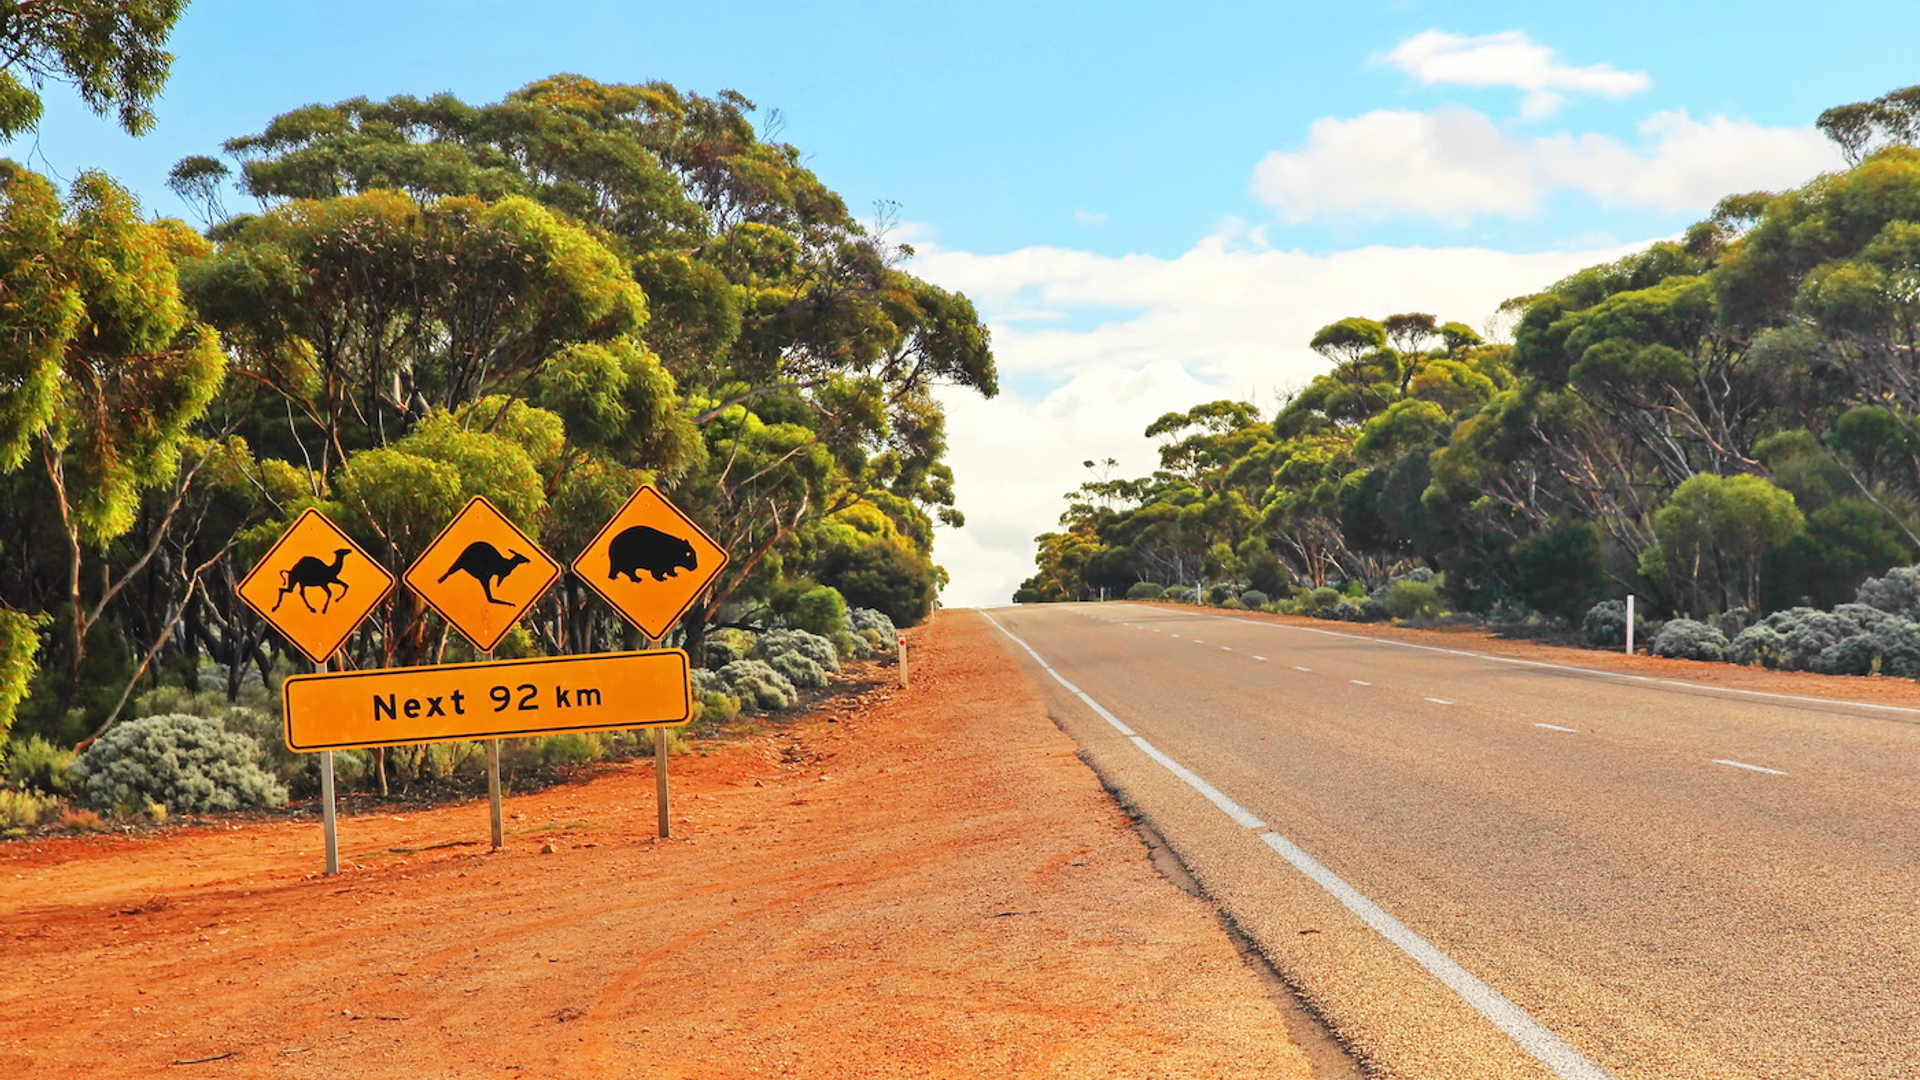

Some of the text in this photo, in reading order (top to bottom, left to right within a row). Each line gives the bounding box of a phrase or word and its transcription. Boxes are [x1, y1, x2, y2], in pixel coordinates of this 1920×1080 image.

[373, 684, 602, 721] Next 92 km
